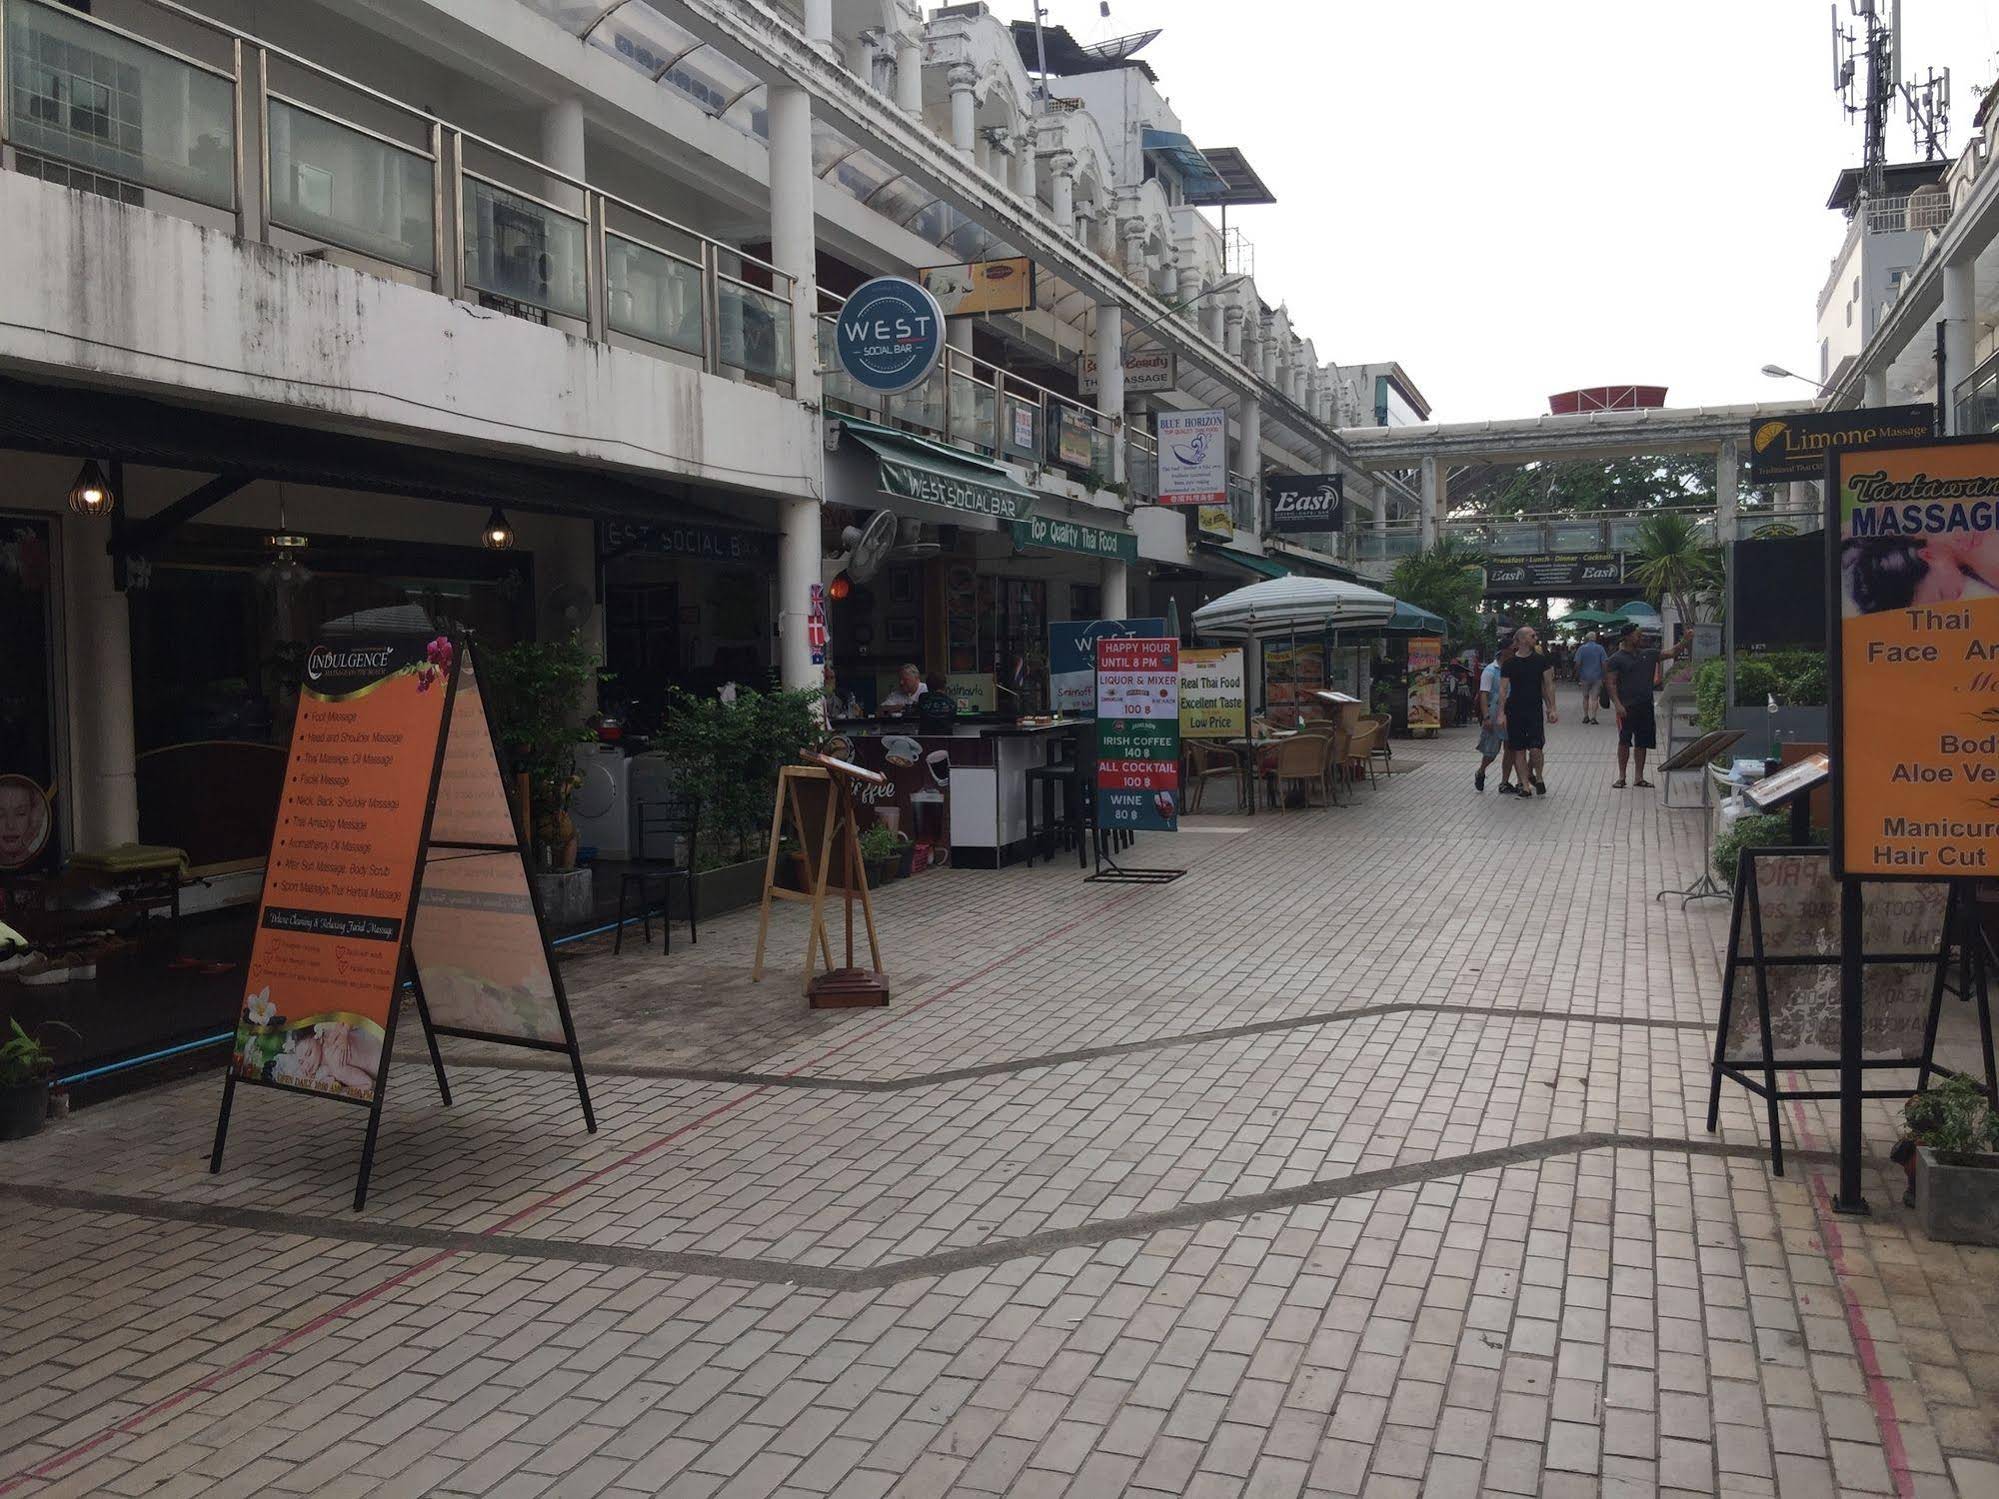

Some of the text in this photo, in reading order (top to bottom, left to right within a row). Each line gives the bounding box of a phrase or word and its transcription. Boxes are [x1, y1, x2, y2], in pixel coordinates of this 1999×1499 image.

[844, 316, 931, 342] WEST
[863, 343, 913, 356] SOCIAL BAR
[1184, 415, 1223, 428] HORIZON
[1784, 425, 1928, 451] Limone Massage
[908, 476, 1016, 517] WEST SOCIAL BAR
[1274, 490, 1331, 512] East
[1050, 521, 1079, 548] Quality
[1081, 527, 1097, 550] Thai
[1098, 530, 1118, 553] Food
[1581, 566, 1618, 579] East
[1905, 609, 1971, 631] Thai
[1106, 643, 1171, 654] HAPPY HOUR
[1867, 641, 1939, 663] Face
[1101, 657, 1157, 668] UNTIL 8 PM
[1100, 675, 1177, 686] LIQUOR & MIXER
[1181, 676, 1241, 690] Real Thai Food
[1124, 704, 1142, 715] 100
[1181, 697, 1242, 710] Excellent Taste
[1190, 715, 1232, 728] Low Price
[1104, 736, 1172, 747] IRISH COFFEE
[1940, 734, 1999, 757] Bod
[1124, 747, 1141, 758] 140
[1099, 762, 1177, 774] ALL COCKTAIL
[1891, 763, 1953, 783] Aloe
[1124, 776, 1141, 787] 100
[1110, 795, 1143, 806] WINE
[1114, 808, 1129, 820] 80
[1873, 845, 1987, 867] Hair Cut
